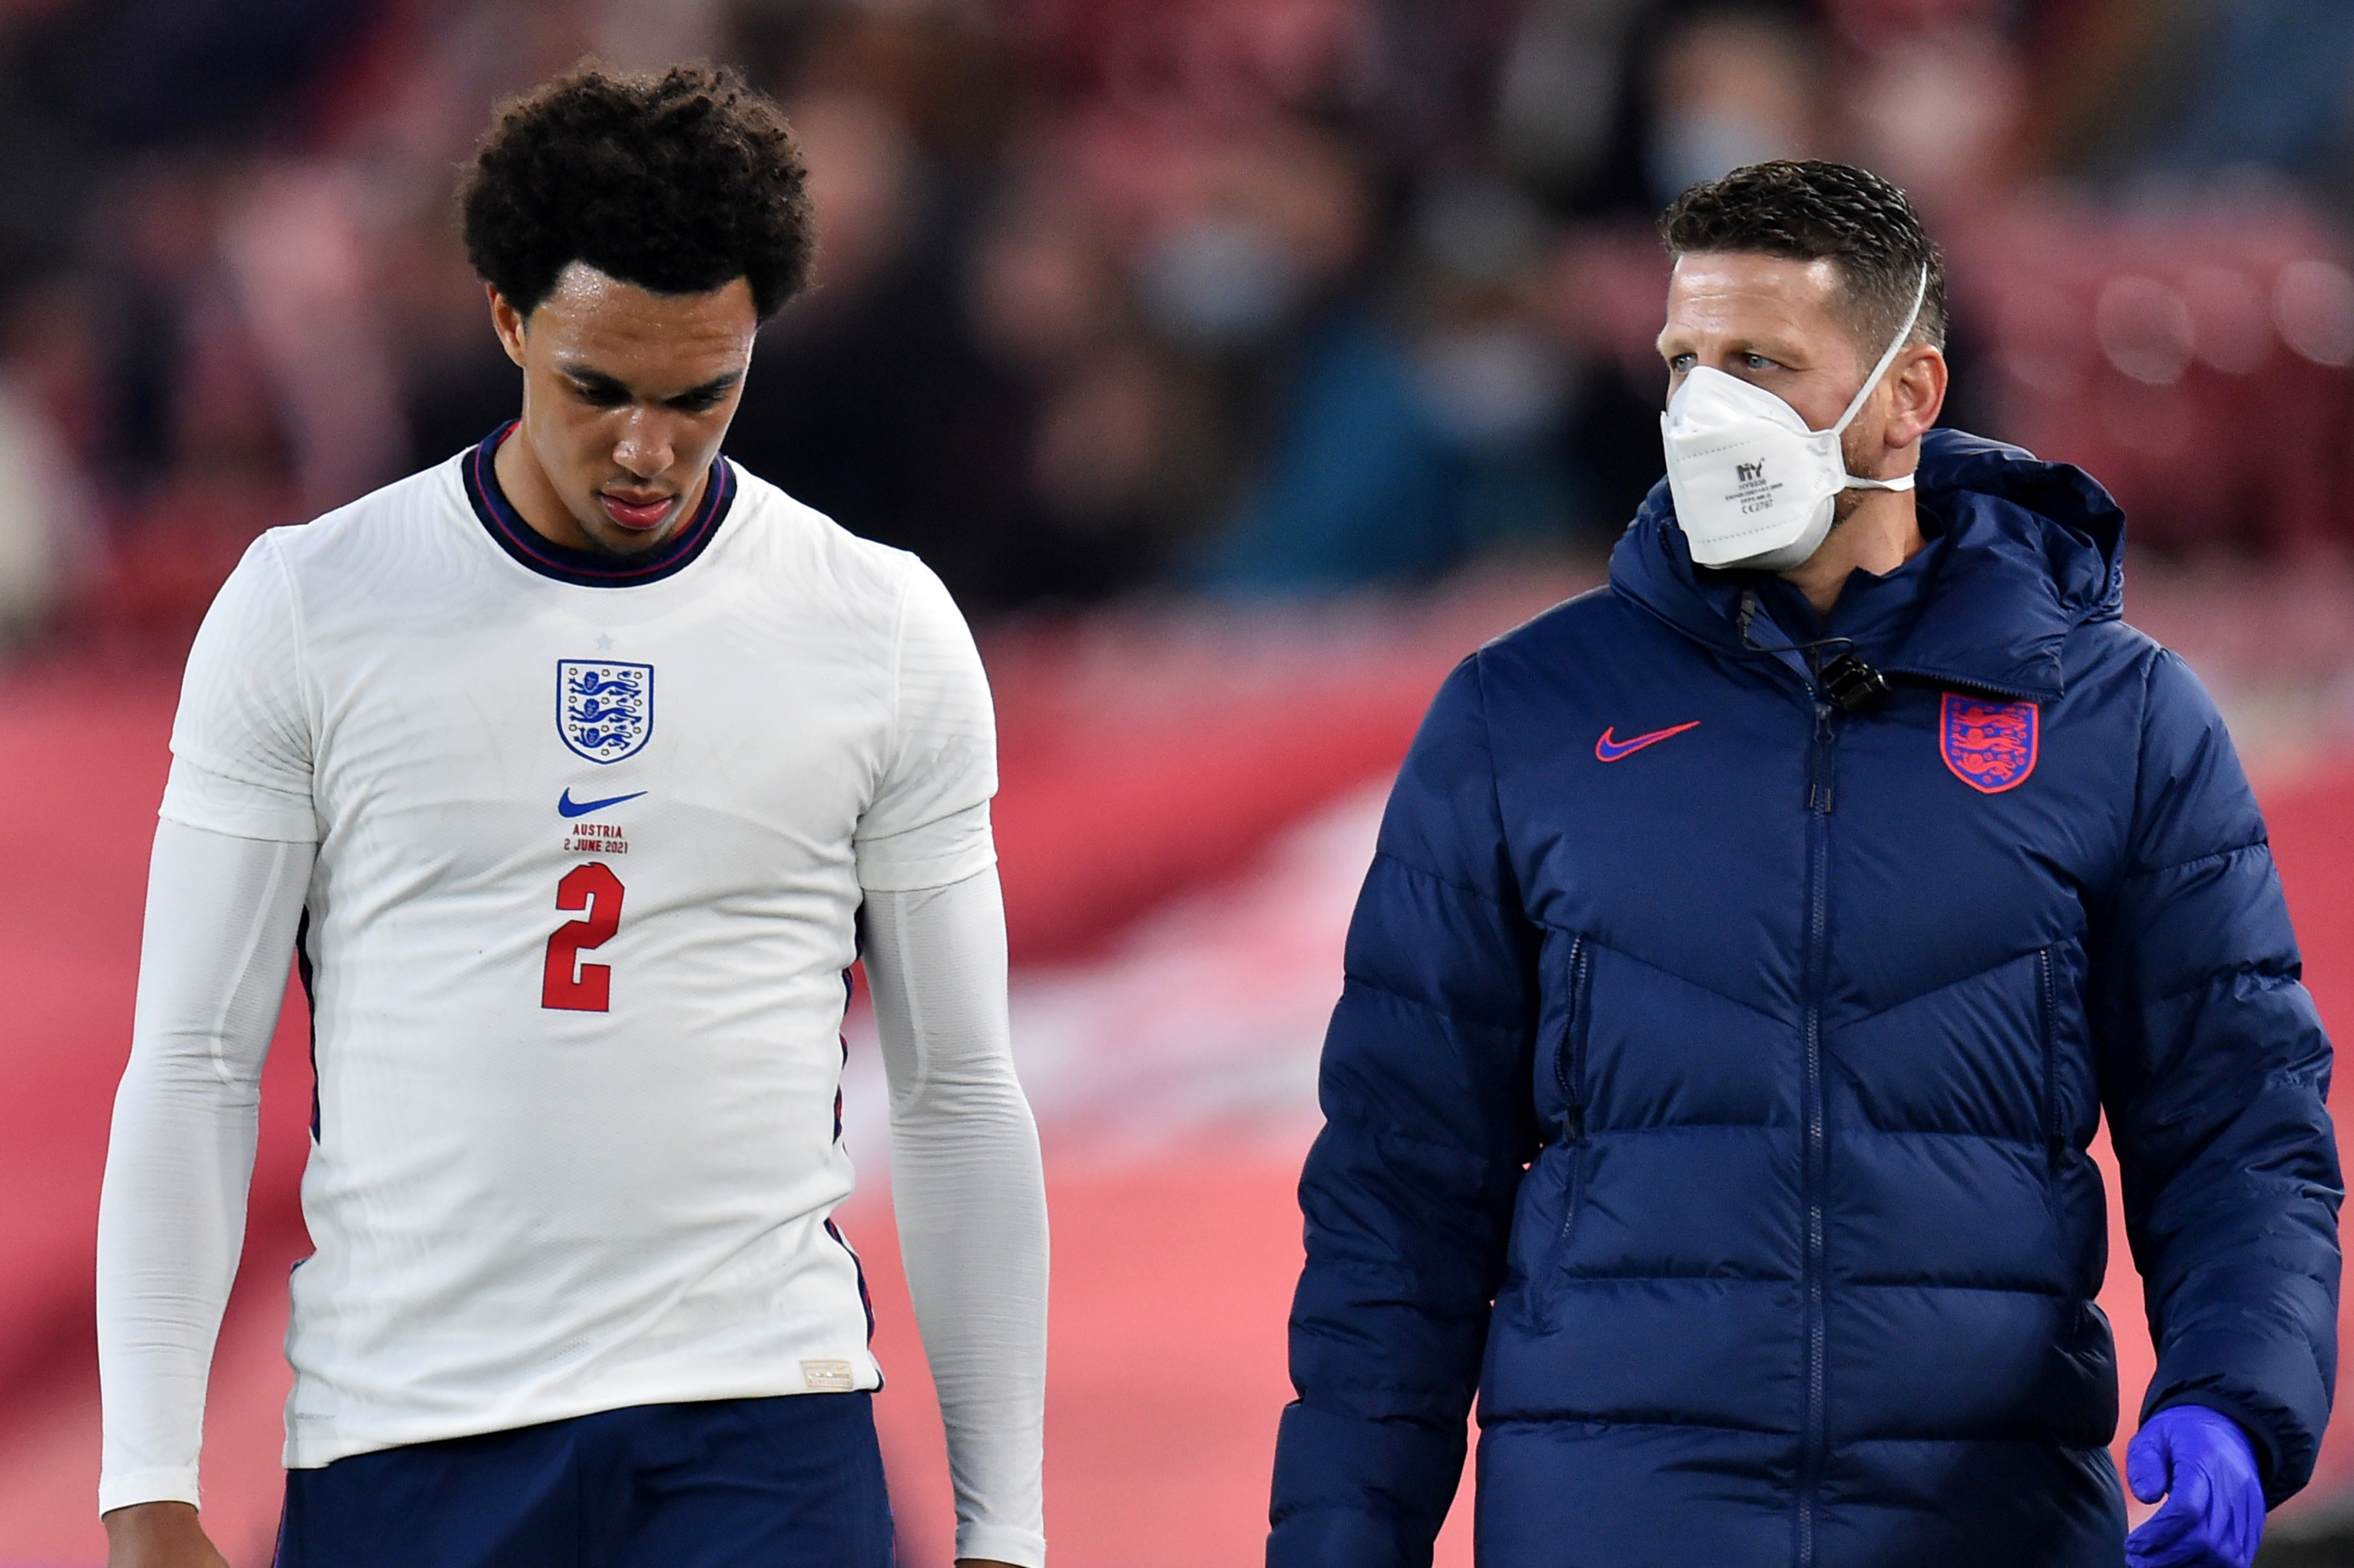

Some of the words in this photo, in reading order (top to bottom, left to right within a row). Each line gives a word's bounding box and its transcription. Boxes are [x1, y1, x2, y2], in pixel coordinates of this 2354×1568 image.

[573, 823, 622, 839] AUSTRIA
[564, 838, 571, 851] 2
[574, 839, 602, 852] JUNE
[605, 840, 628, 854] 2021
[541, 862, 625, 1012] 2
